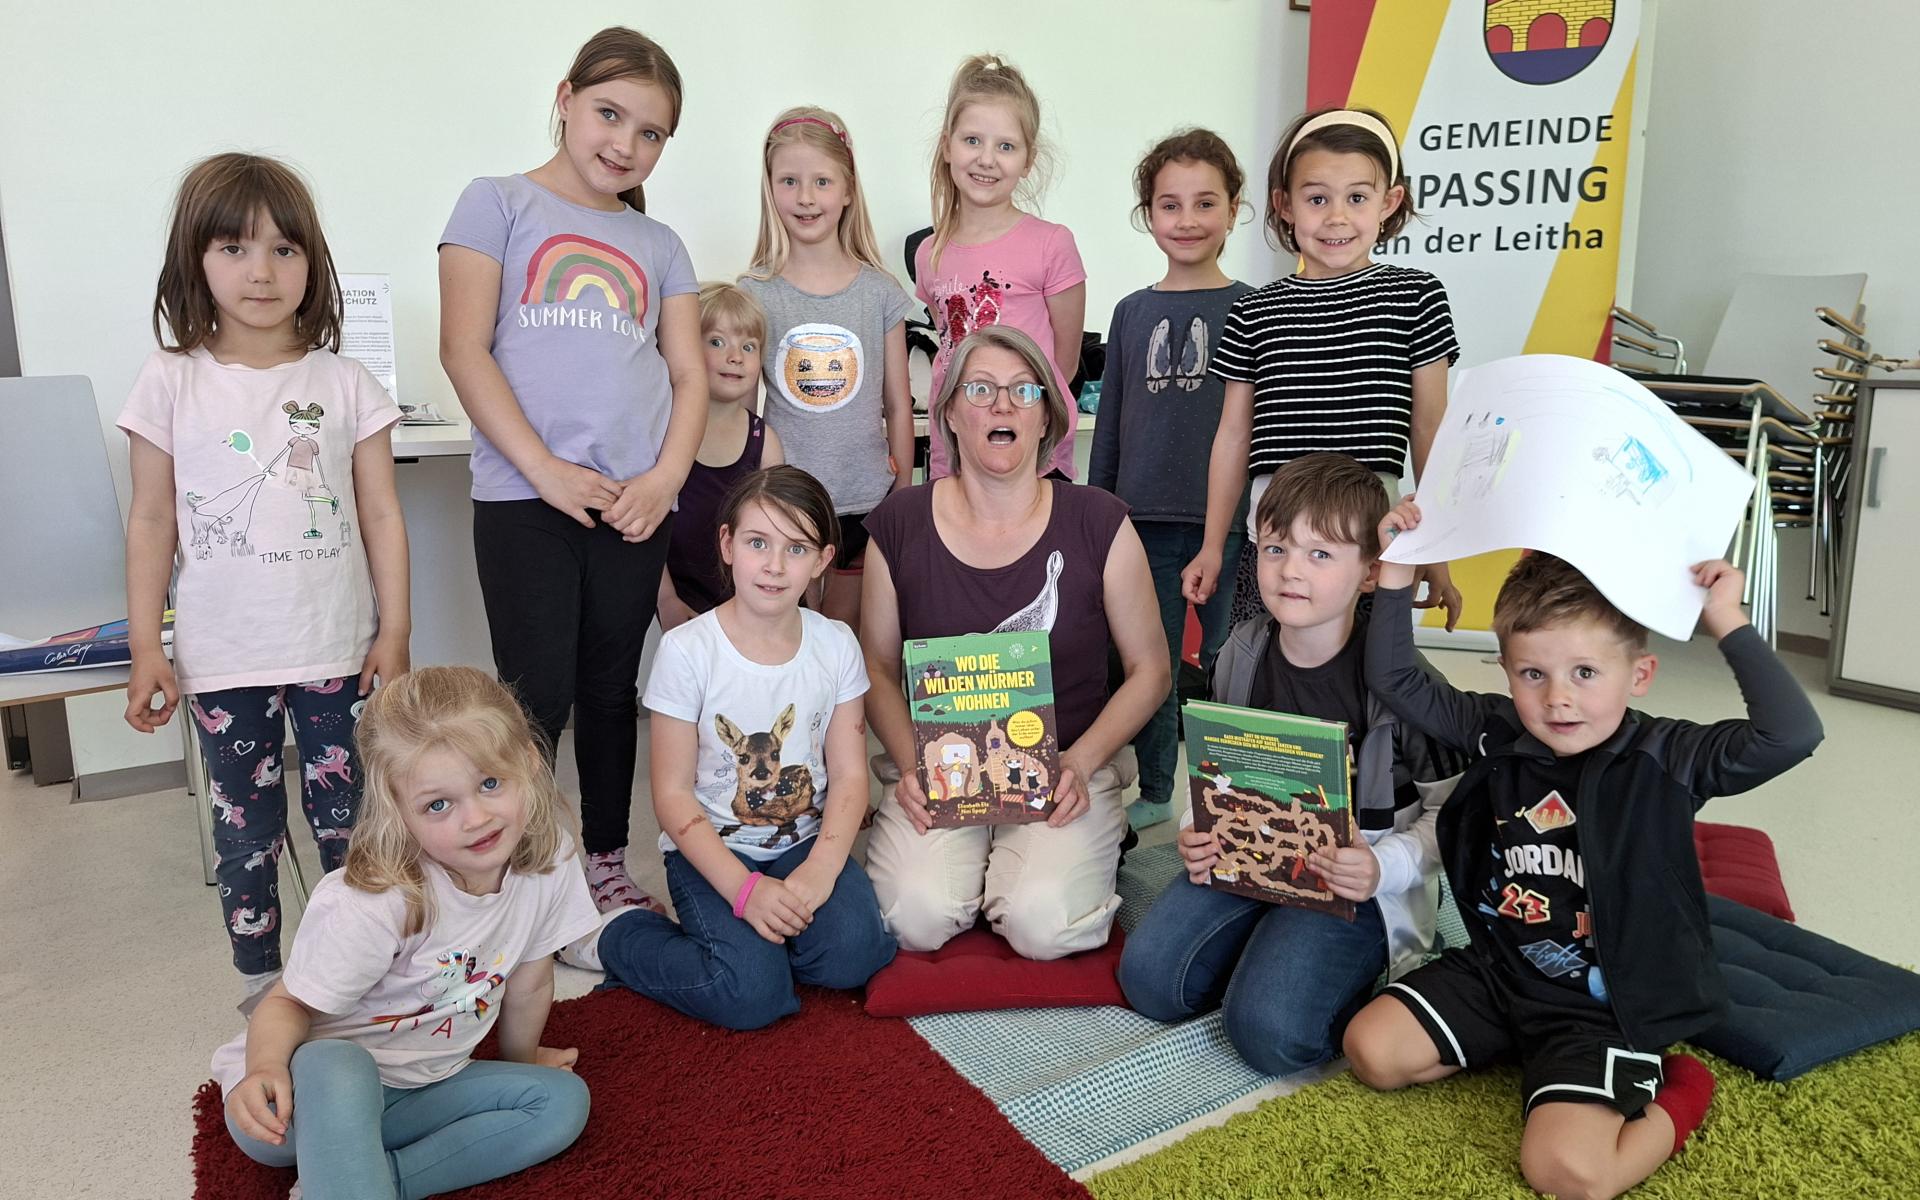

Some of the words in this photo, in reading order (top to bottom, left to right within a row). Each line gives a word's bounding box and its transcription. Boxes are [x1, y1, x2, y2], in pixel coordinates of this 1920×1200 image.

[1420, 114, 1614, 151] GEMEINDE
[1405, 165, 1609, 209] PASSING
[1425, 227, 1481, 254] der
[1495, 222, 1604, 252] Leitha
[518, 305, 603, 329] SUMMER
[259, 551, 293, 564] TIME
[298, 549, 314, 561] TO
[317, 548, 342, 561] PLAY
[44, 652, 67, 665] Color
[67, 643, 93, 665] Copy
[955, 655, 976, 672] WO
[979, 653, 1000, 671] DIE
[925, 676, 975, 695] WILDEN
[976, 669, 1035, 691] WÜRMER
[953, 693, 1010, 711] WOHNEN
[1497, 882, 1551, 925] 23
